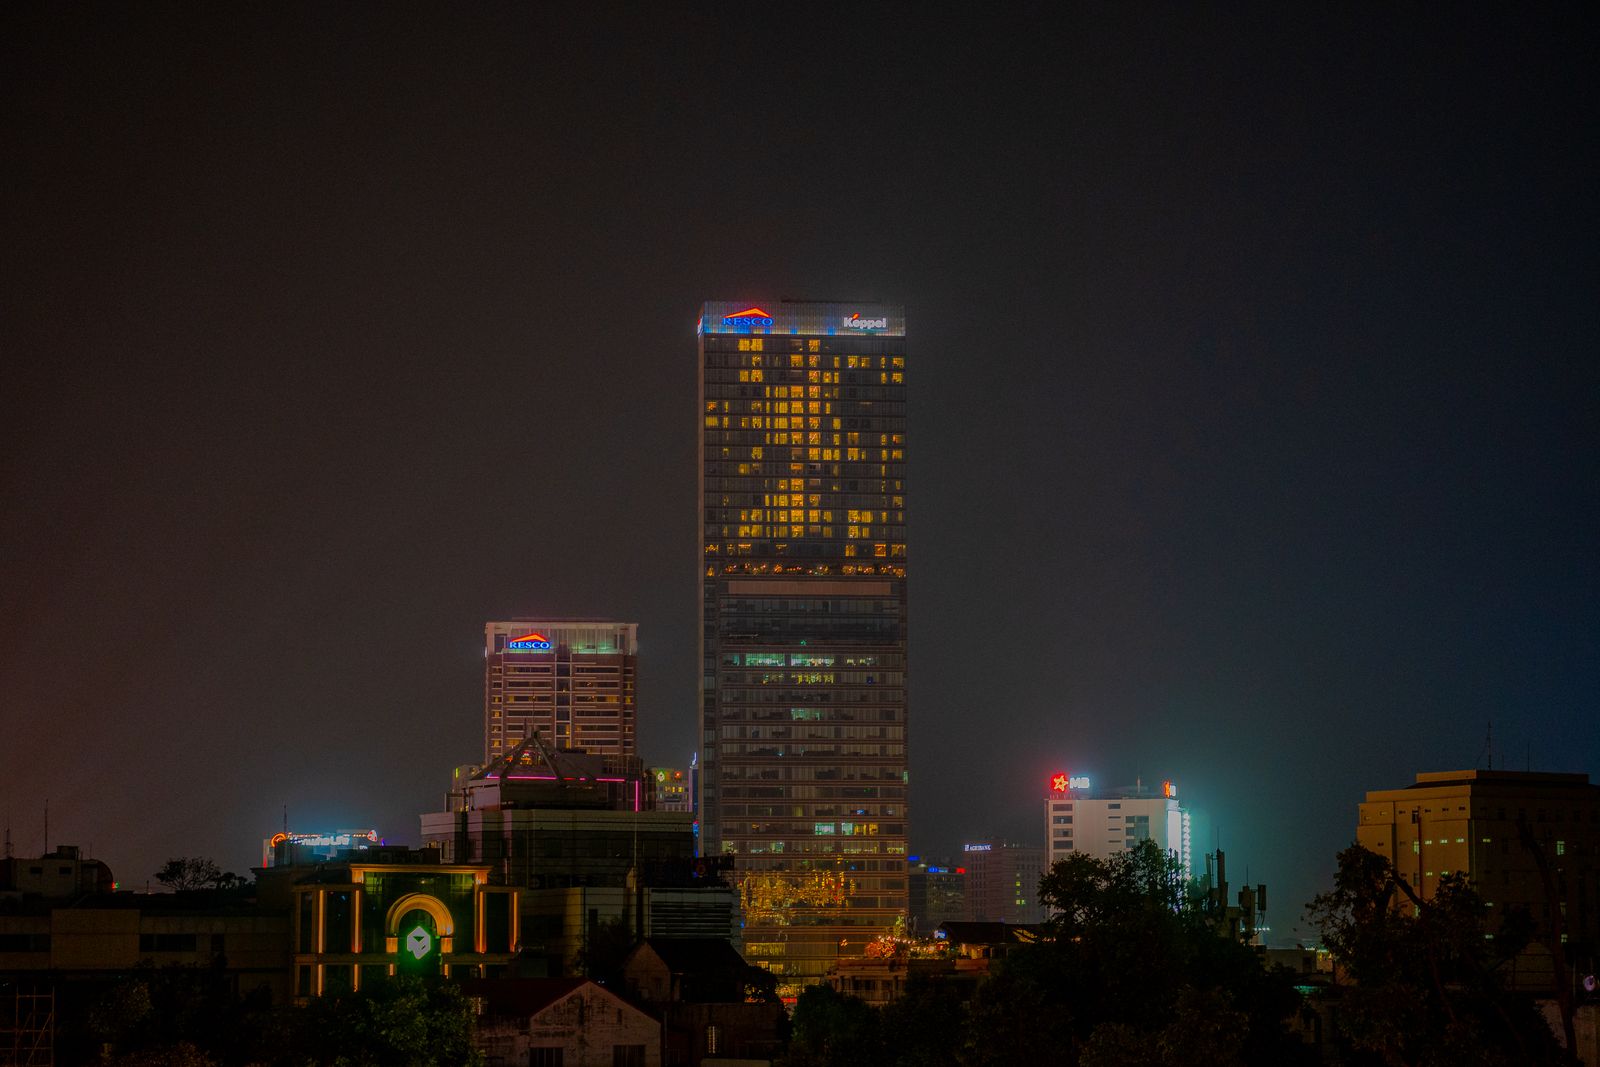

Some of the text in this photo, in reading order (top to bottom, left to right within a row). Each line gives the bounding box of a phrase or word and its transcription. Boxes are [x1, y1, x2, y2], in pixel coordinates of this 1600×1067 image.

[722, 318, 773, 326] RESCO
[843, 316, 886, 329] Keppel
[509, 641, 550, 649] RESCO
[1069, 777, 1090, 789] MB
